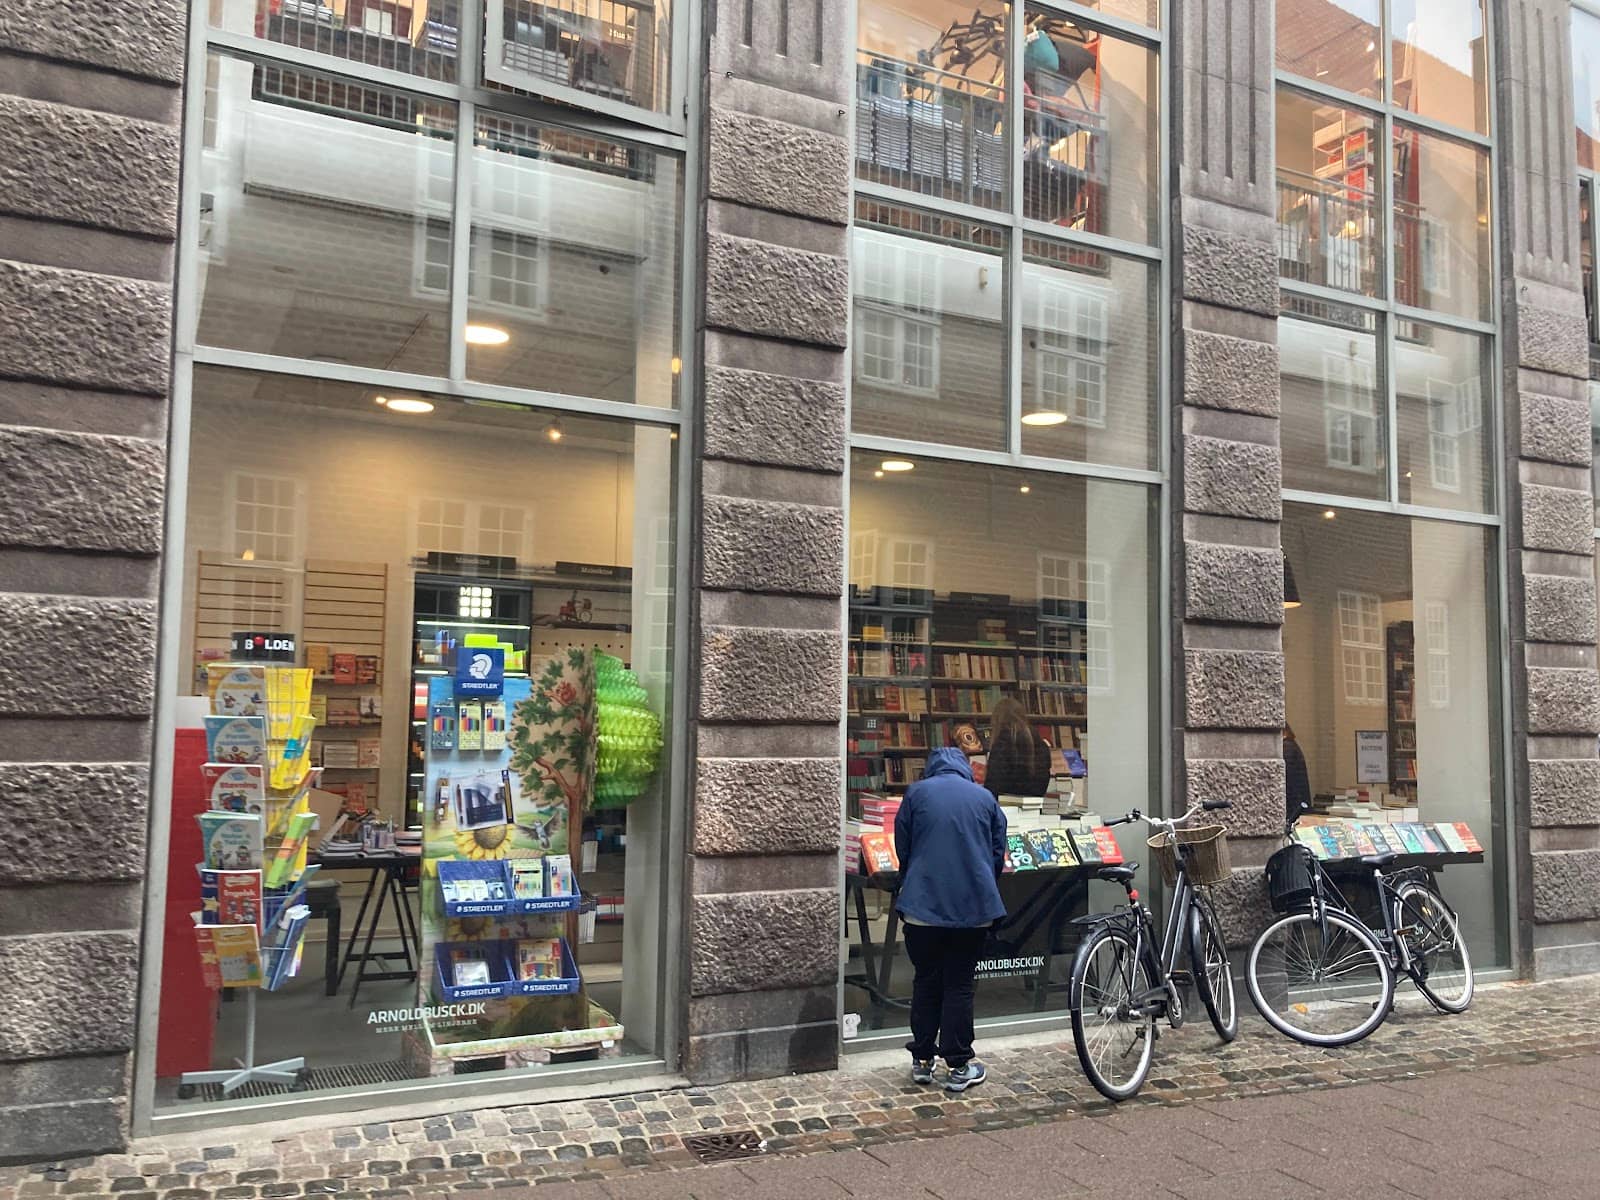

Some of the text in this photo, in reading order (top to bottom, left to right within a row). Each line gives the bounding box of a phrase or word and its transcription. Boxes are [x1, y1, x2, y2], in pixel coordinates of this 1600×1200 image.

[463, 905, 504, 913] STAEDTLER
[531, 901, 570, 909] STAEDTLER
[974, 955, 1045, 972] RNOLDBUSCK.DK
[460, 987, 500, 996] STAEDTLER
[529, 984, 568, 992] STAEDTLER
[367, 1001, 486, 1024] ARNOLDBUSCK.DK
